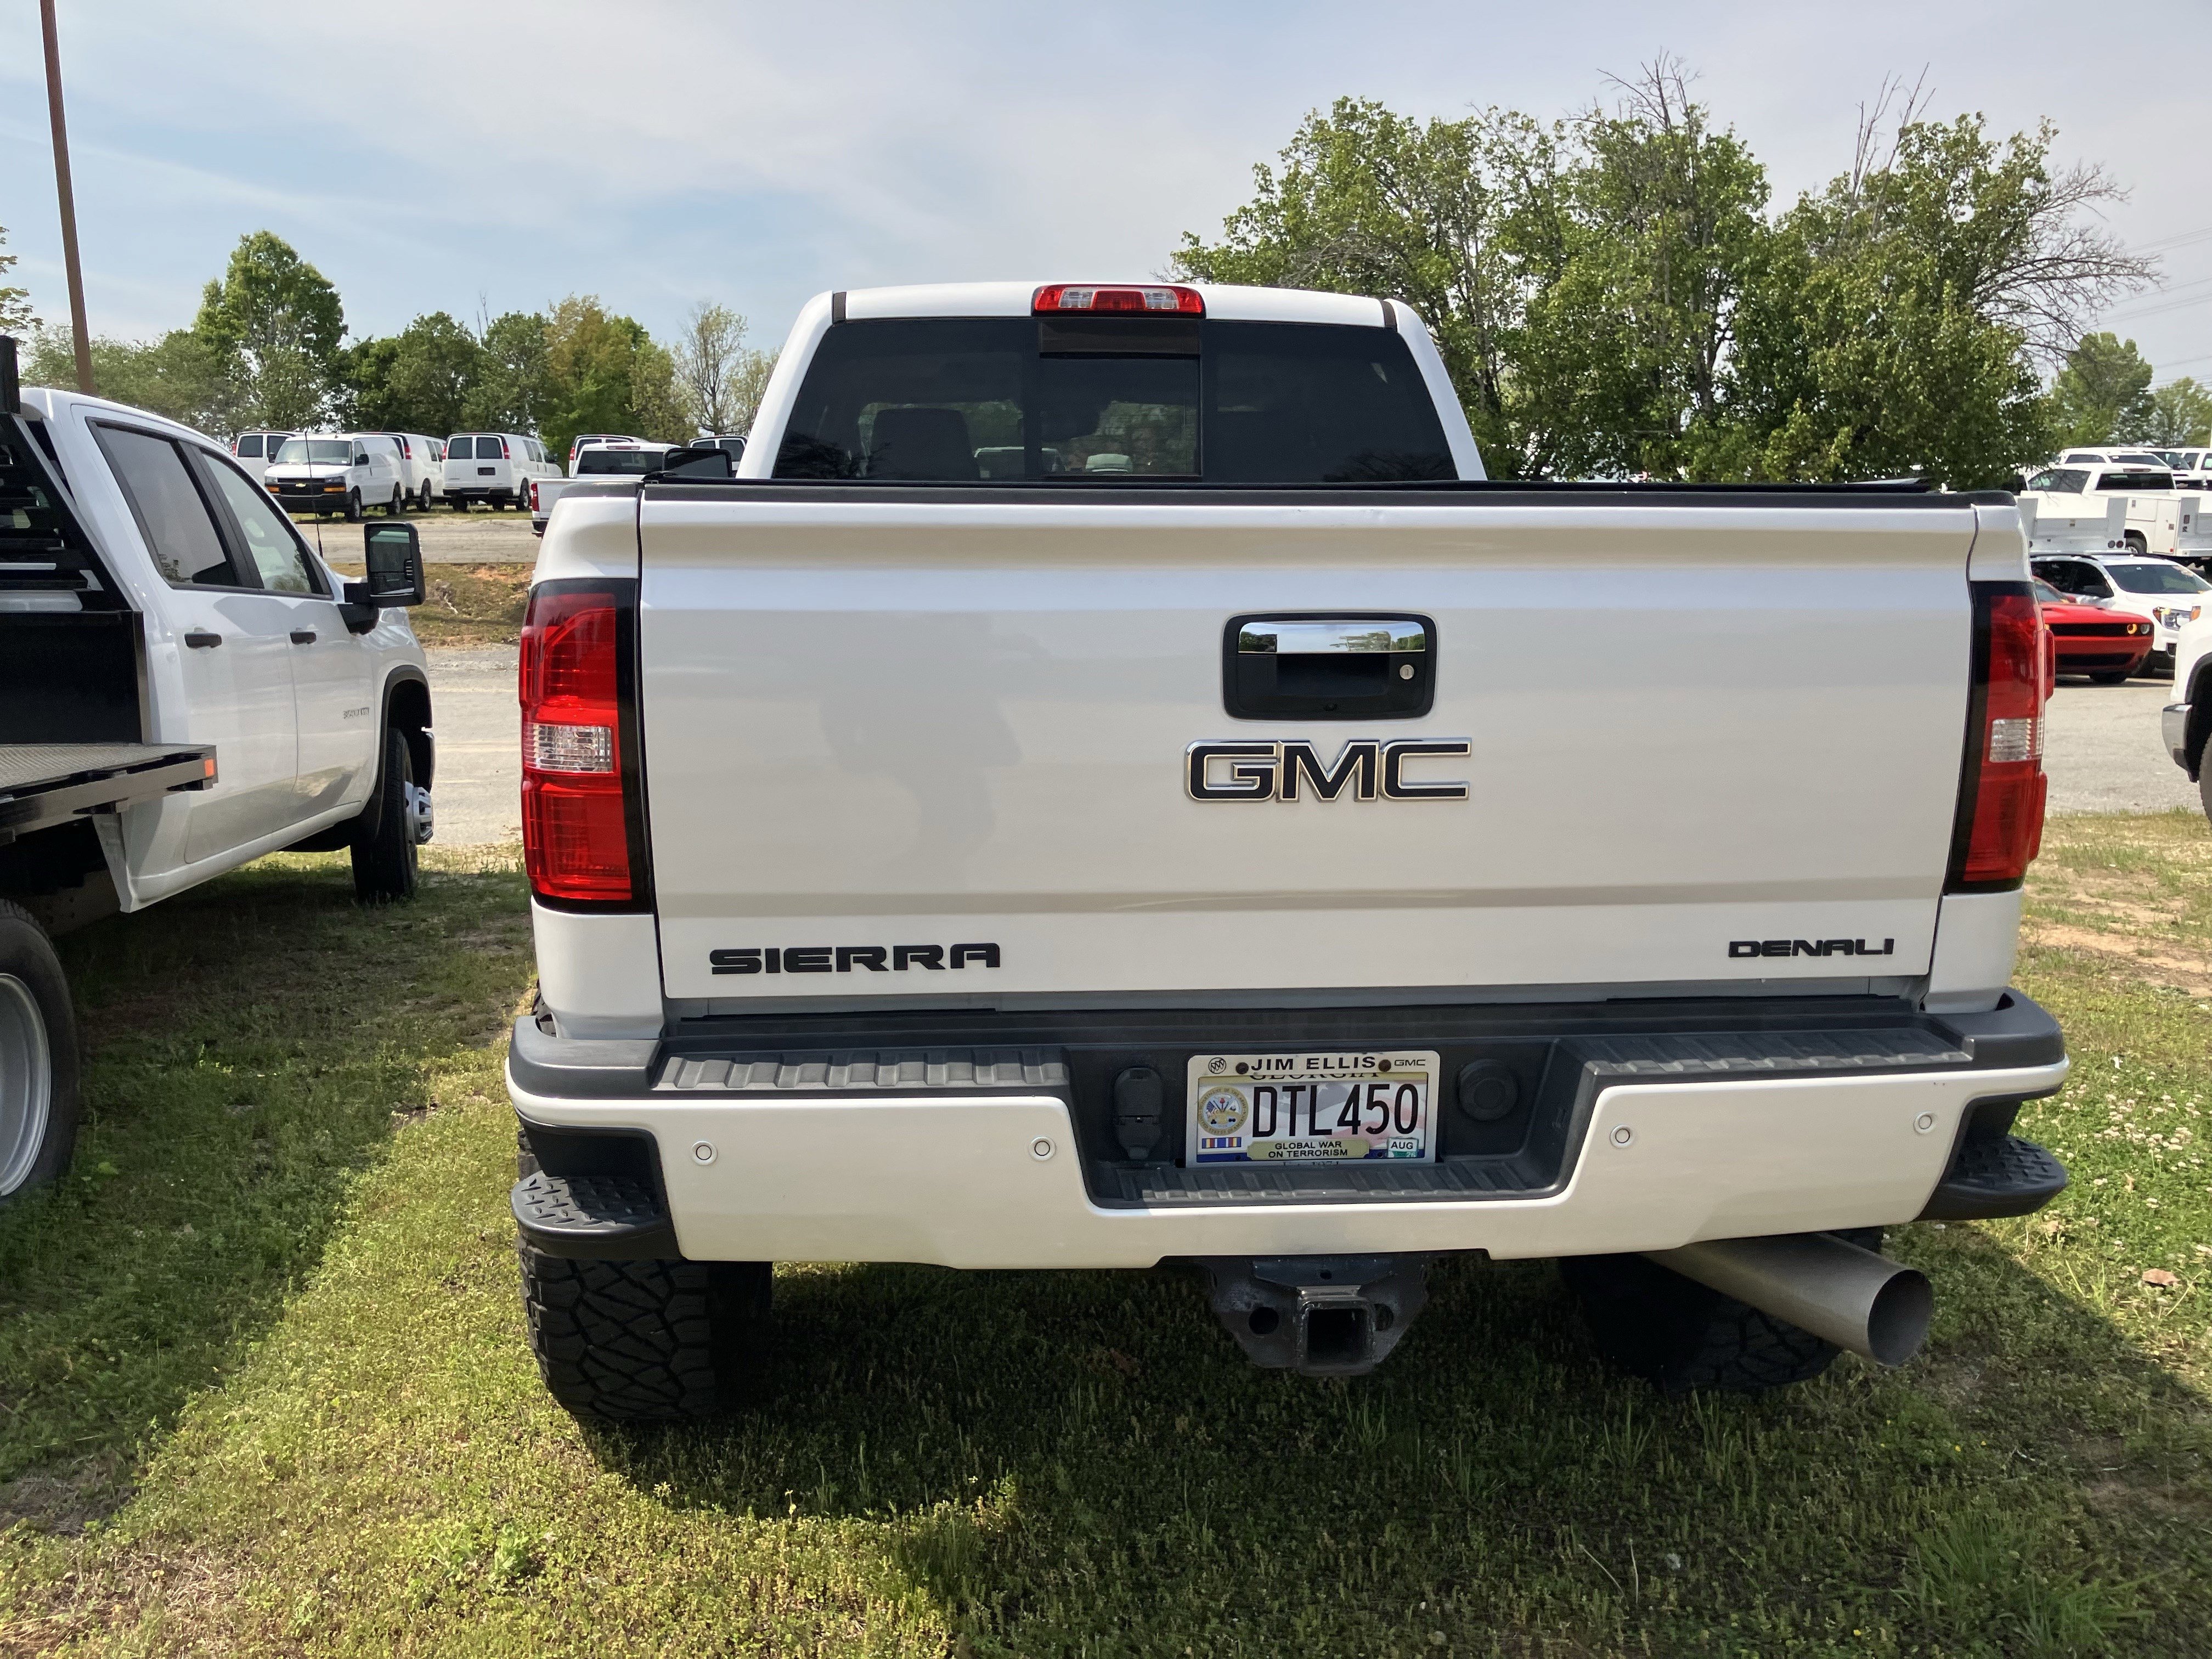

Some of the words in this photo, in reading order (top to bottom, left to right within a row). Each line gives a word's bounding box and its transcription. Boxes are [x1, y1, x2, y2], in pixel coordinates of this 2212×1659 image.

[1184, 738, 1472, 803] GMC
[1728, 938, 1895, 958] DENALI
[709, 943, 1001, 975] SIERRA
[1251, 1058, 1294, 1071] JIM
[1306, 1057, 1375, 1070] ELLIS
[1286, 1149, 1348, 1157] TERRORISM
[1391, 1141, 1413, 1149] AUG
